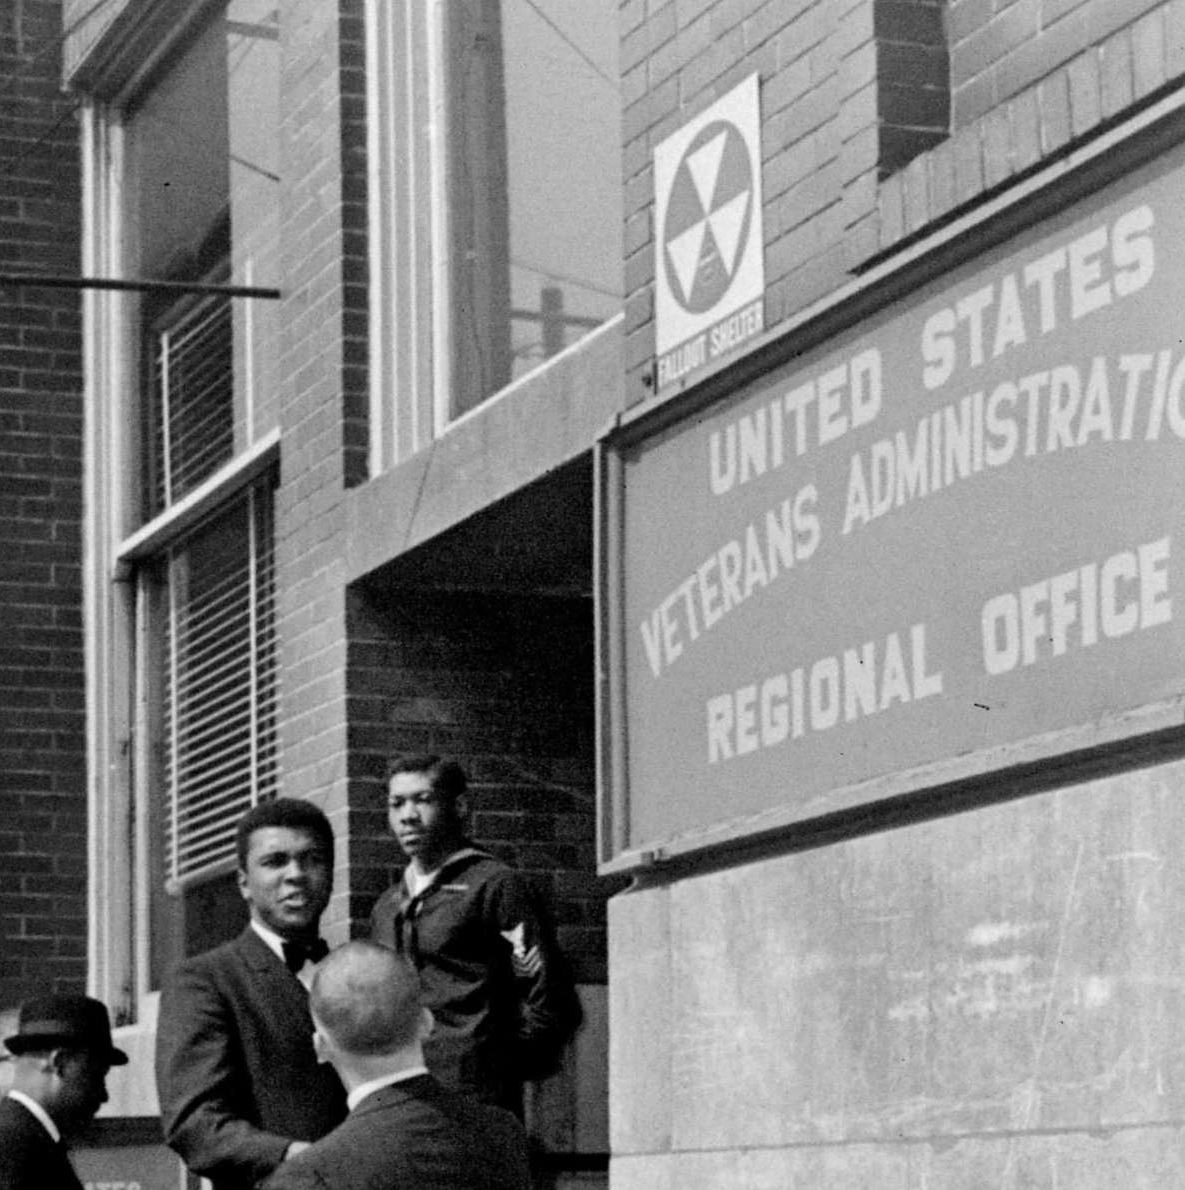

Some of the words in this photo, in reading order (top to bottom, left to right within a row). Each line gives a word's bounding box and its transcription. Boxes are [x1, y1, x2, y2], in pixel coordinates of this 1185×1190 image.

[709, 347, 882, 496] UNITED
[921, 204, 1155, 390] STATES
[641, 483, 820, 678] VETERANS
[706, 623, 943, 764] REGIONAL
[981, 534, 1172, 675] OFFICE
